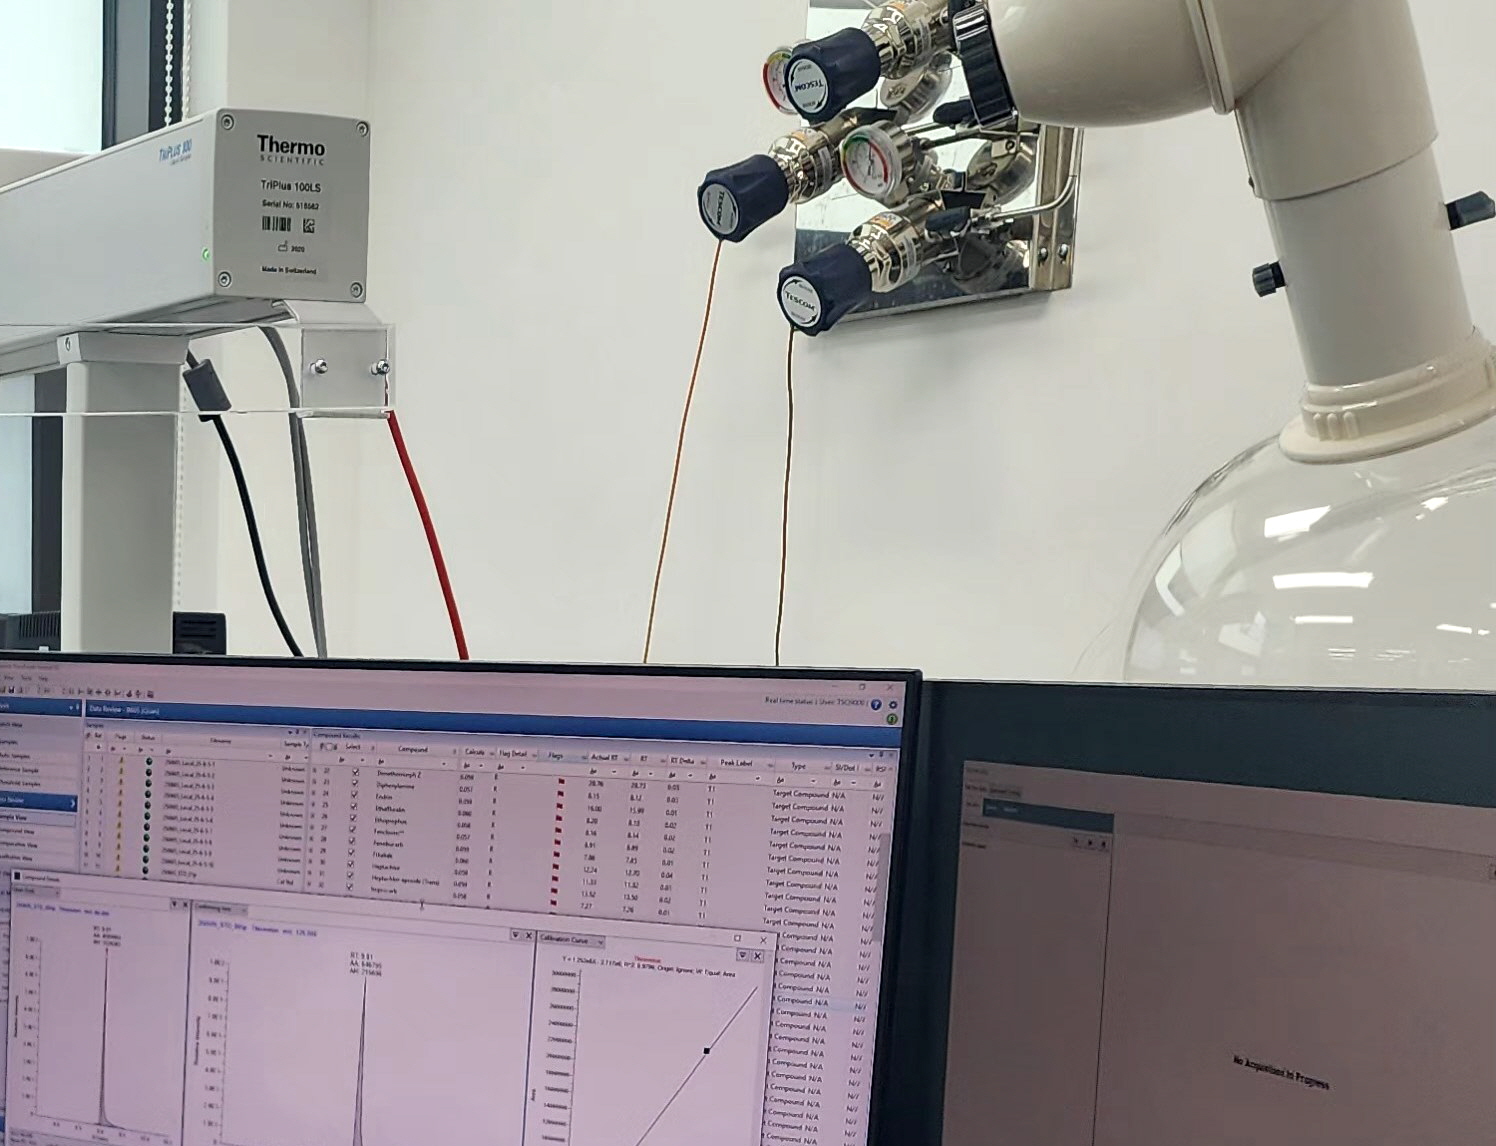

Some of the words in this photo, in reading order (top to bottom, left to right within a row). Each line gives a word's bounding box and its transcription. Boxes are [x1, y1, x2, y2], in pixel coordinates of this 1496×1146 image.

[794, 79, 824, 92] TESCOM
[257, 134, 325, 156] Thermo
[260, 154, 325, 166] SCIENTIFIC
[261, 180, 292, 191] TriPlus
[294, 182, 321, 193] 100LS
[785, 290, 816, 312] TESCOM
[398, 746, 428, 754] Compound
[791, 762, 806, 770] Type
[773, 789, 792, 798] Target
[793, 790, 830, 800] Compound
[831, 792, 846, 800] N/A
[772, 801, 791, 811] Target
[792, 803, 829, 813] Compound
[830, 805, 845, 813] N/A
[771, 814, 790, 824] Target
[791, 816, 827, 826] Compound
[829, 818, 844, 826] N/A
[769, 840, 788, 850] Target
[789, 841, 825, 851] Compound
[827, 844, 842, 852] N/A
[768, 853, 787, 863] Target
[788, 854, 824, 864] Compound
[826, 857, 841, 865] N/A
[766, 878, 785, 889] Target
[786, 880, 822, 890] Compound
[824, 883, 838, 891] N/A
[765, 891, 784, 901] Target
[785, 893, 821, 903] Compound
[763, 917, 782, 927] Target
[783, 919, 819, 929] Compound
[540, 933, 570, 944] Calibration
[571, 936, 588, 946] Curve
[782, 931, 818, 941] Compound
[820, 934, 834, 942] N/A
[775, 1018, 811, 1029] Compound
[1234, 1055, 1243, 1065] No
[767, 1118, 803, 1130] Compound
[805, 1123, 819, 1131] N/A
